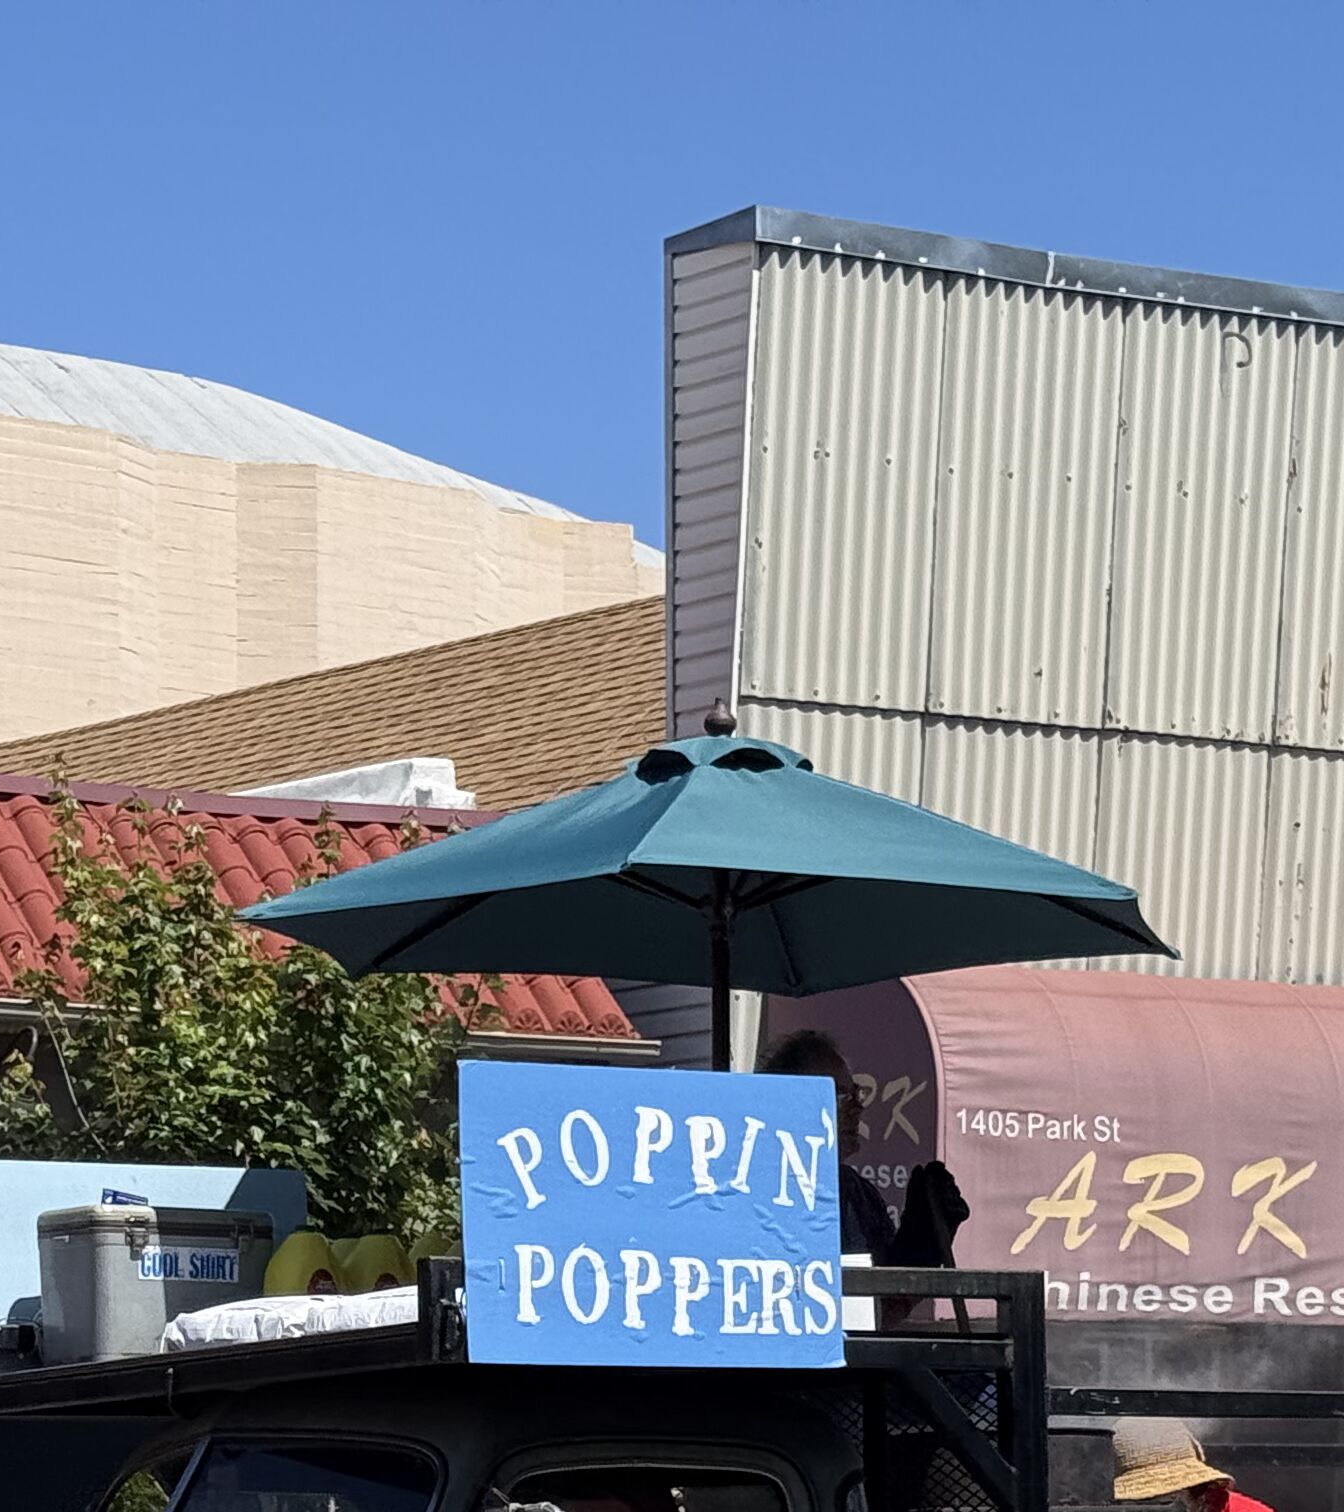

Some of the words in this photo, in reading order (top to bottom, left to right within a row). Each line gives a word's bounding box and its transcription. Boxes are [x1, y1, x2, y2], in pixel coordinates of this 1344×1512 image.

[852, 1073, 927, 1145] RK
[956, 1108, 1020, 1138] 1405
[1027, 1112, 1087, 1141] Park
[1093, 1115, 1121, 1143] St
[497, 1106, 834, 1211] POPPIN'
[1010, 1150, 1317, 1259] ARK
[141, 1253, 184, 1278] COOL
[189, 1253, 238, 1281] SHIRT
[513, 1242, 838, 1337] POPPERS
[1044, 1270, 1234, 1313] hinese
